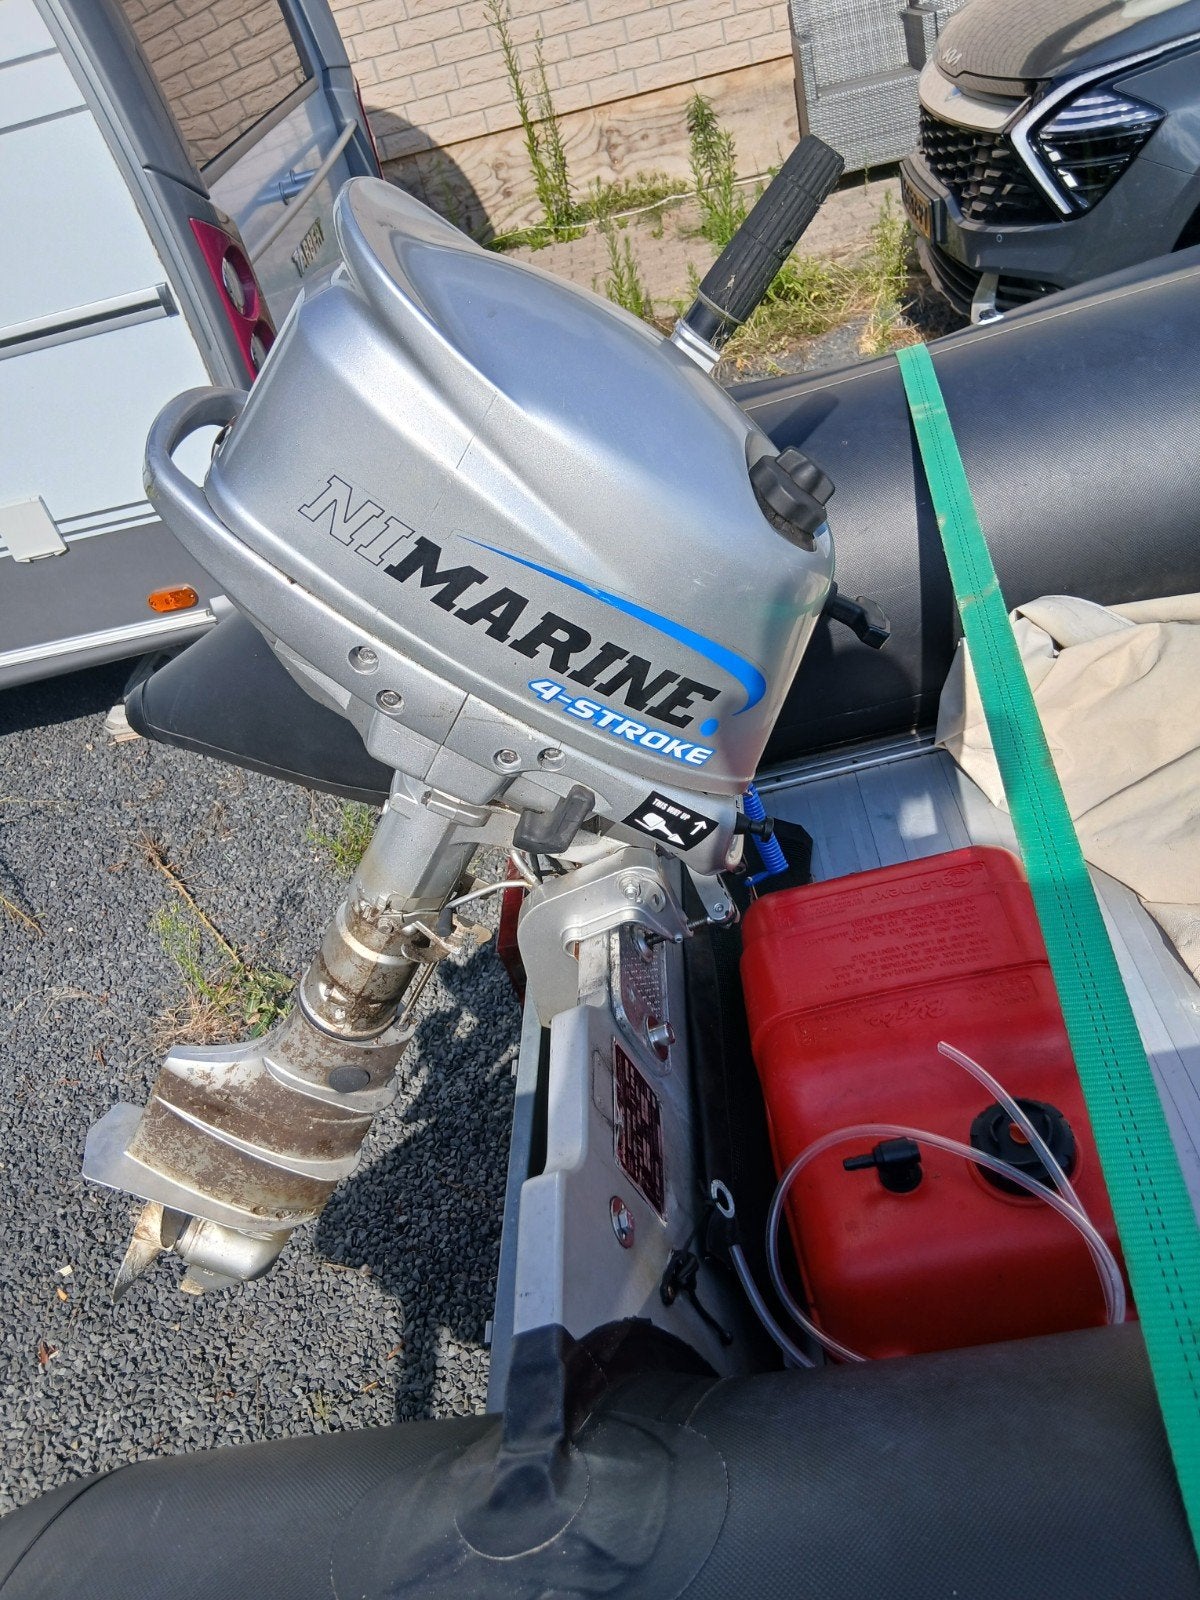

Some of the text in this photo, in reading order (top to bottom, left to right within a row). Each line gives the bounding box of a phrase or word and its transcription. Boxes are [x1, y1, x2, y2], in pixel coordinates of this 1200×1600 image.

[298, 475, 720, 729] NIMARINE
[527, 677, 716, 767] 4-STROKE
[652, 798, 691, 821] THIS WAY UP
